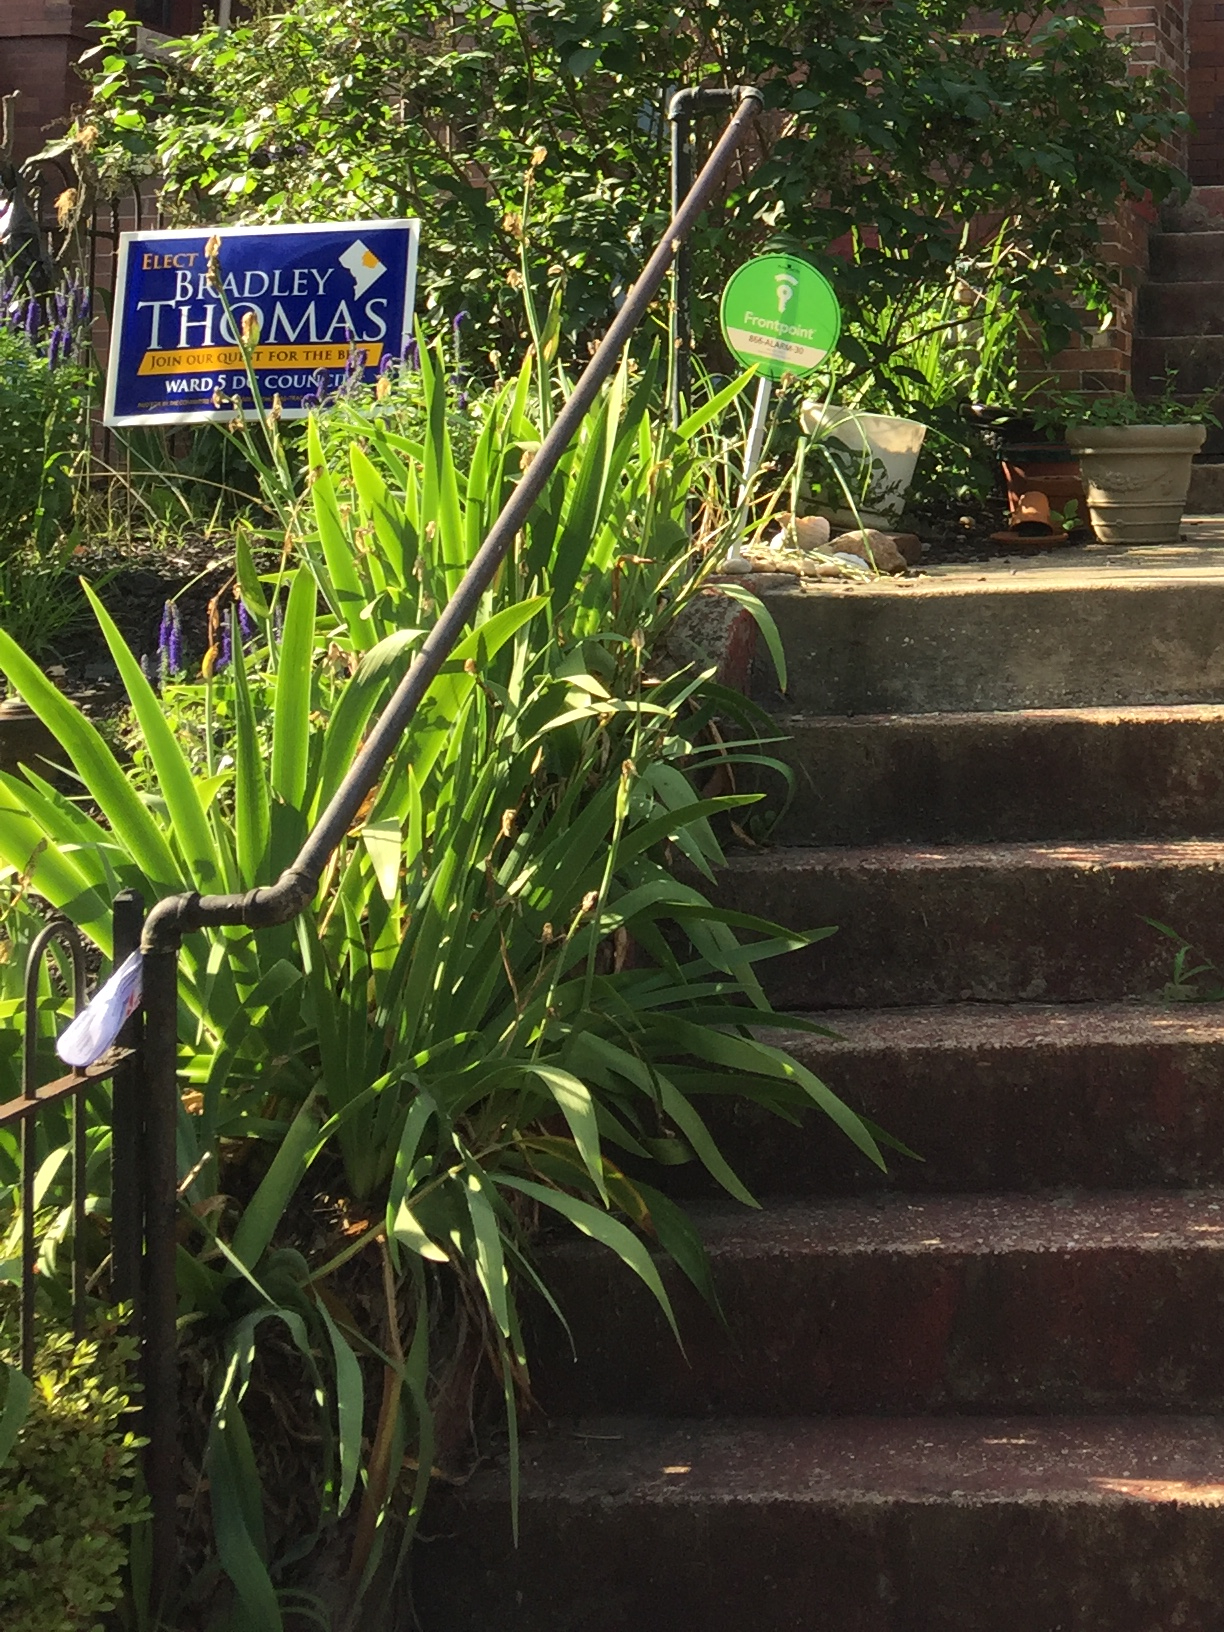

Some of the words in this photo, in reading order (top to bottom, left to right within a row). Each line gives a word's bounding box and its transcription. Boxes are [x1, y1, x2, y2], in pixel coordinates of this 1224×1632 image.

[142, 252, 199, 271] ELECT
[174, 268, 334, 302] BRADLEY
[136, 298, 388, 350] THOMAS
[744, 310, 815, 340] Frontpoint
[150, 355, 183, 370] JOIN
[186, 353, 214, 366] OUR
[217, 351, 264, 365] QUT
[268, 350, 299, 362] FOR
[303, 349, 333, 361] THE
[165, 377, 213, 394] WARD
[217, 374, 227, 390] 5
